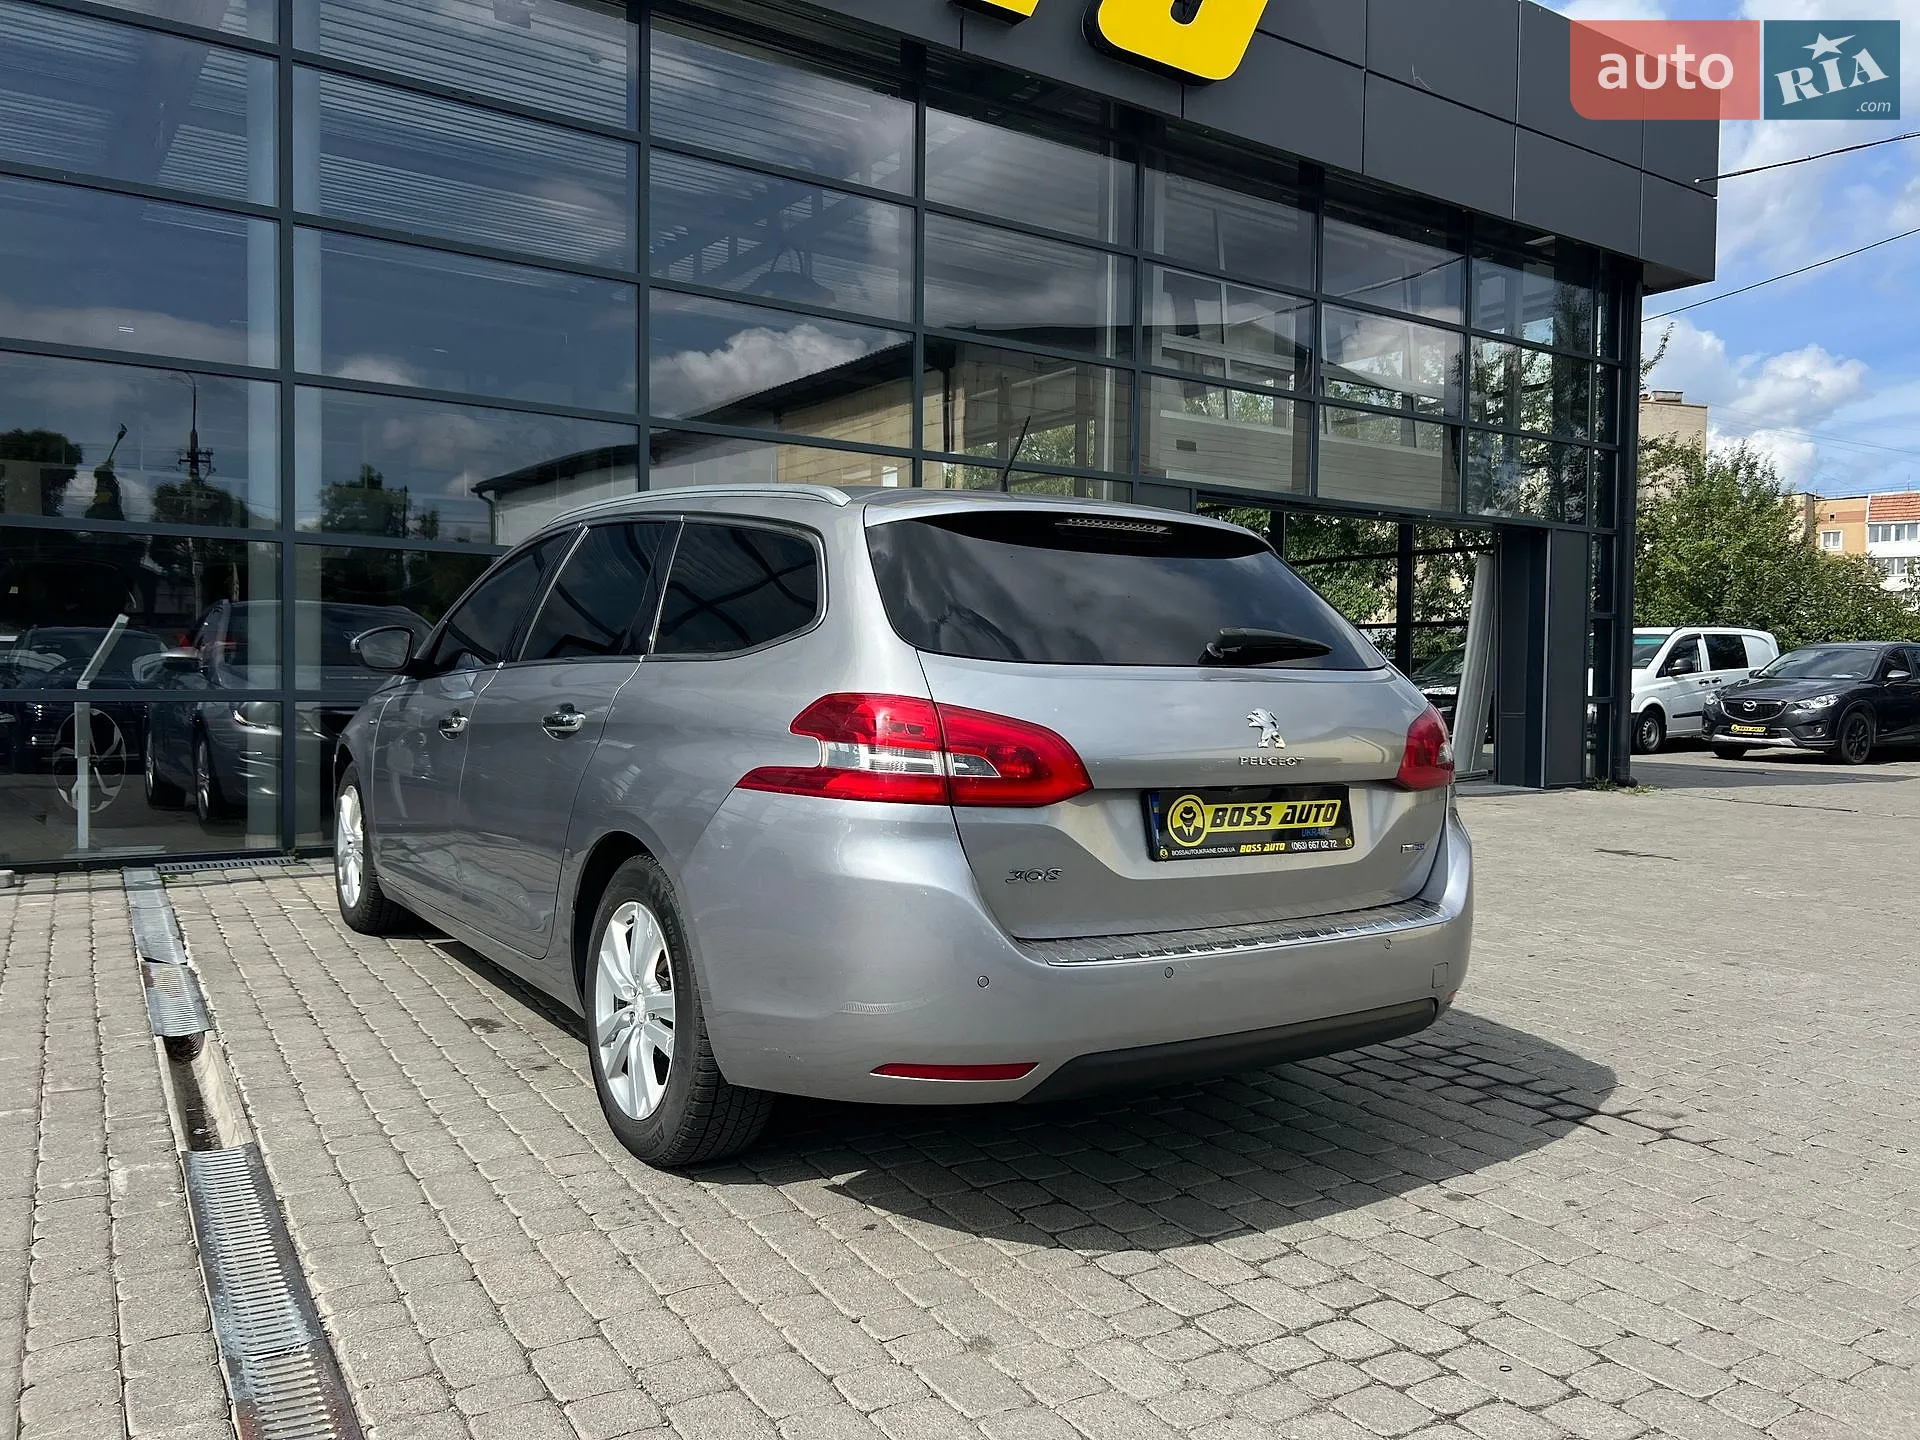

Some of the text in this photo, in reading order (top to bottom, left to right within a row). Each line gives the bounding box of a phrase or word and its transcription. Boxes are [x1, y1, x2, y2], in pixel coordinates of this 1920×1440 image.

[1239, 756, 1305, 766] PEUGEOT
[1210, 803, 1337, 828] BOSS AUTO
[1301, 827, 1332, 837] UKRAINE
[1240, 844, 1261, 853] BOSS
[1263, 842, 1286, 852] AUTO
[1291, 841, 1308, 850] (063)
[1308, 840, 1320, 849] 667
[1320, 840, 1329, 848] 02
[1329, 839, 1338, 848] 72
